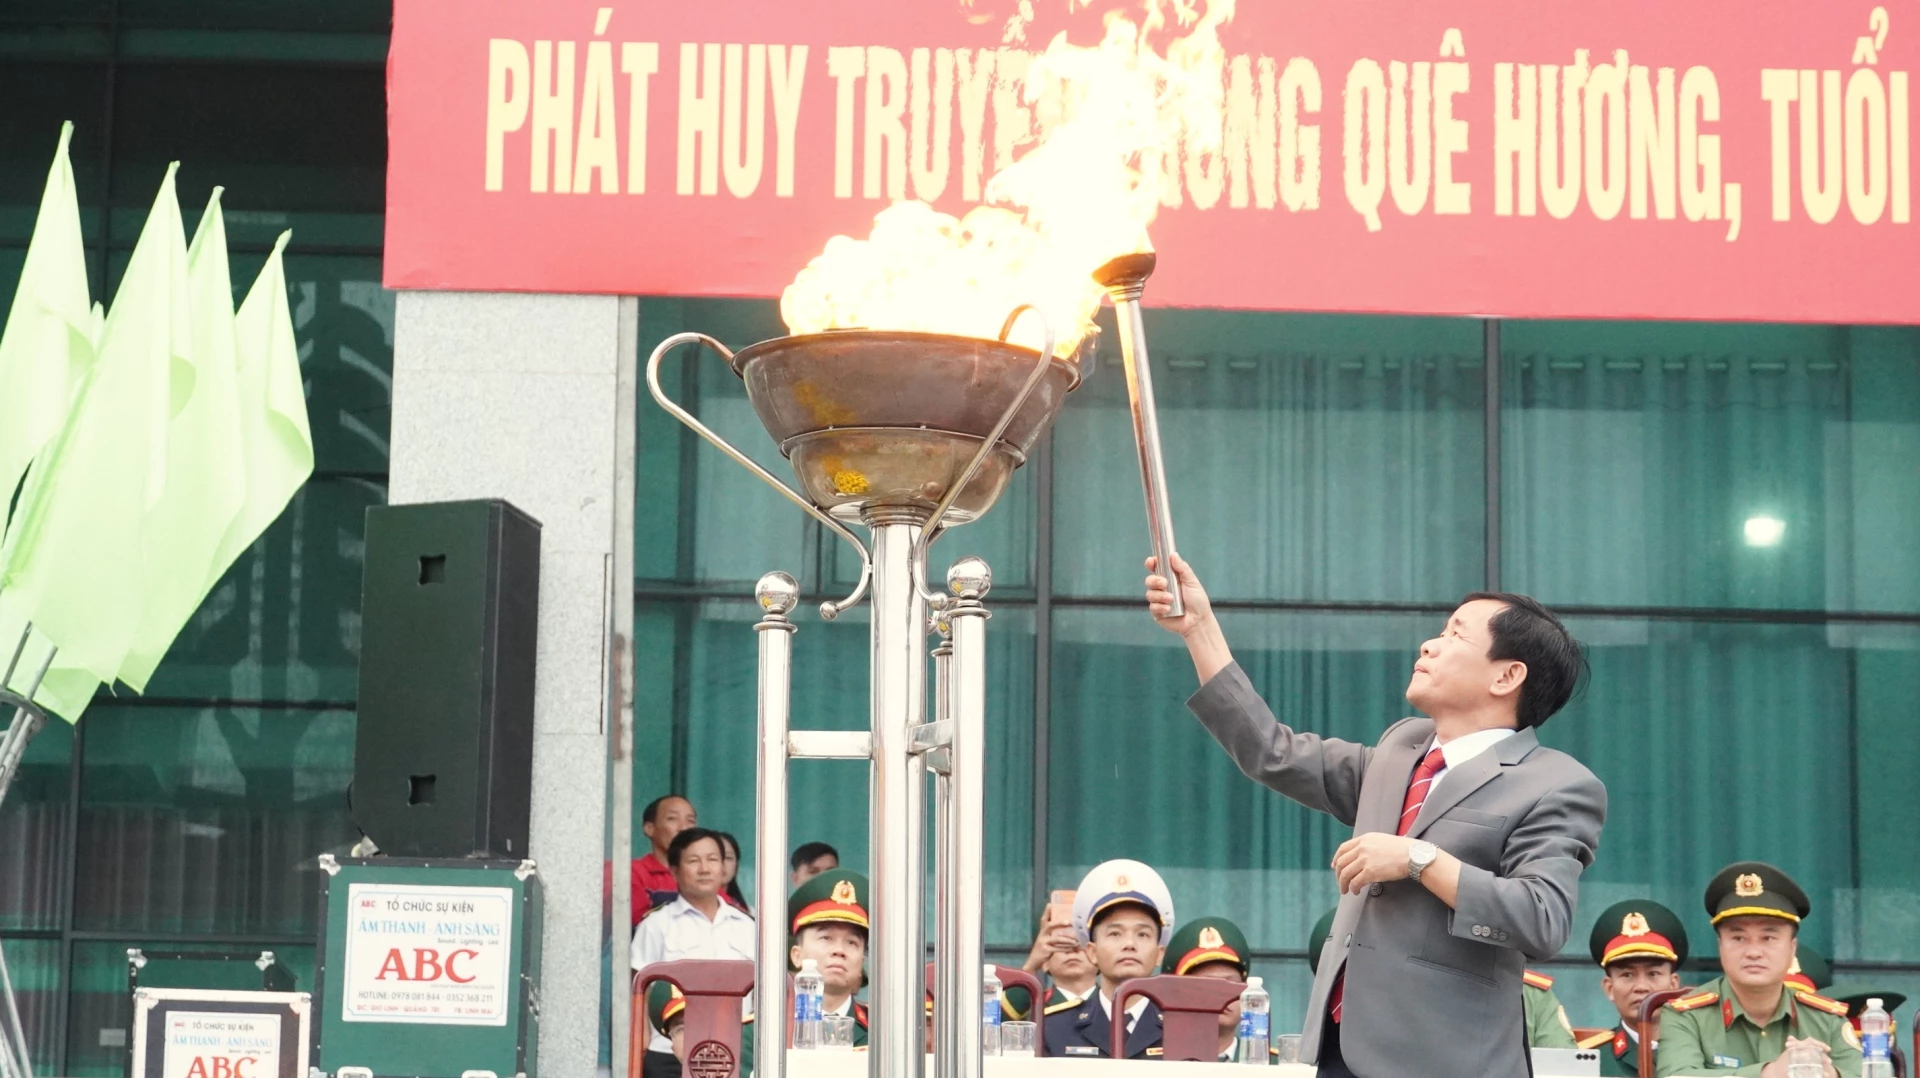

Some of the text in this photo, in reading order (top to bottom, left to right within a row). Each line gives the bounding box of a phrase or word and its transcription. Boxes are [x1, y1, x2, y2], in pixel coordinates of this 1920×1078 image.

[485, 7, 659, 195] PHÁT
[676, 41, 809, 198] HUY
[1342, 28, 1471, 231] QUÊ
[1494, 48, 1741, 241] HƯƠNG,
[1761, 6, 1910, 225] TUỔI
[361, 900, 376, 908] ABC
[381, 920, 426, 934] THANH
[375, 948, 479, 984] ABC
[185, 1056, 258, 1078] ABC
